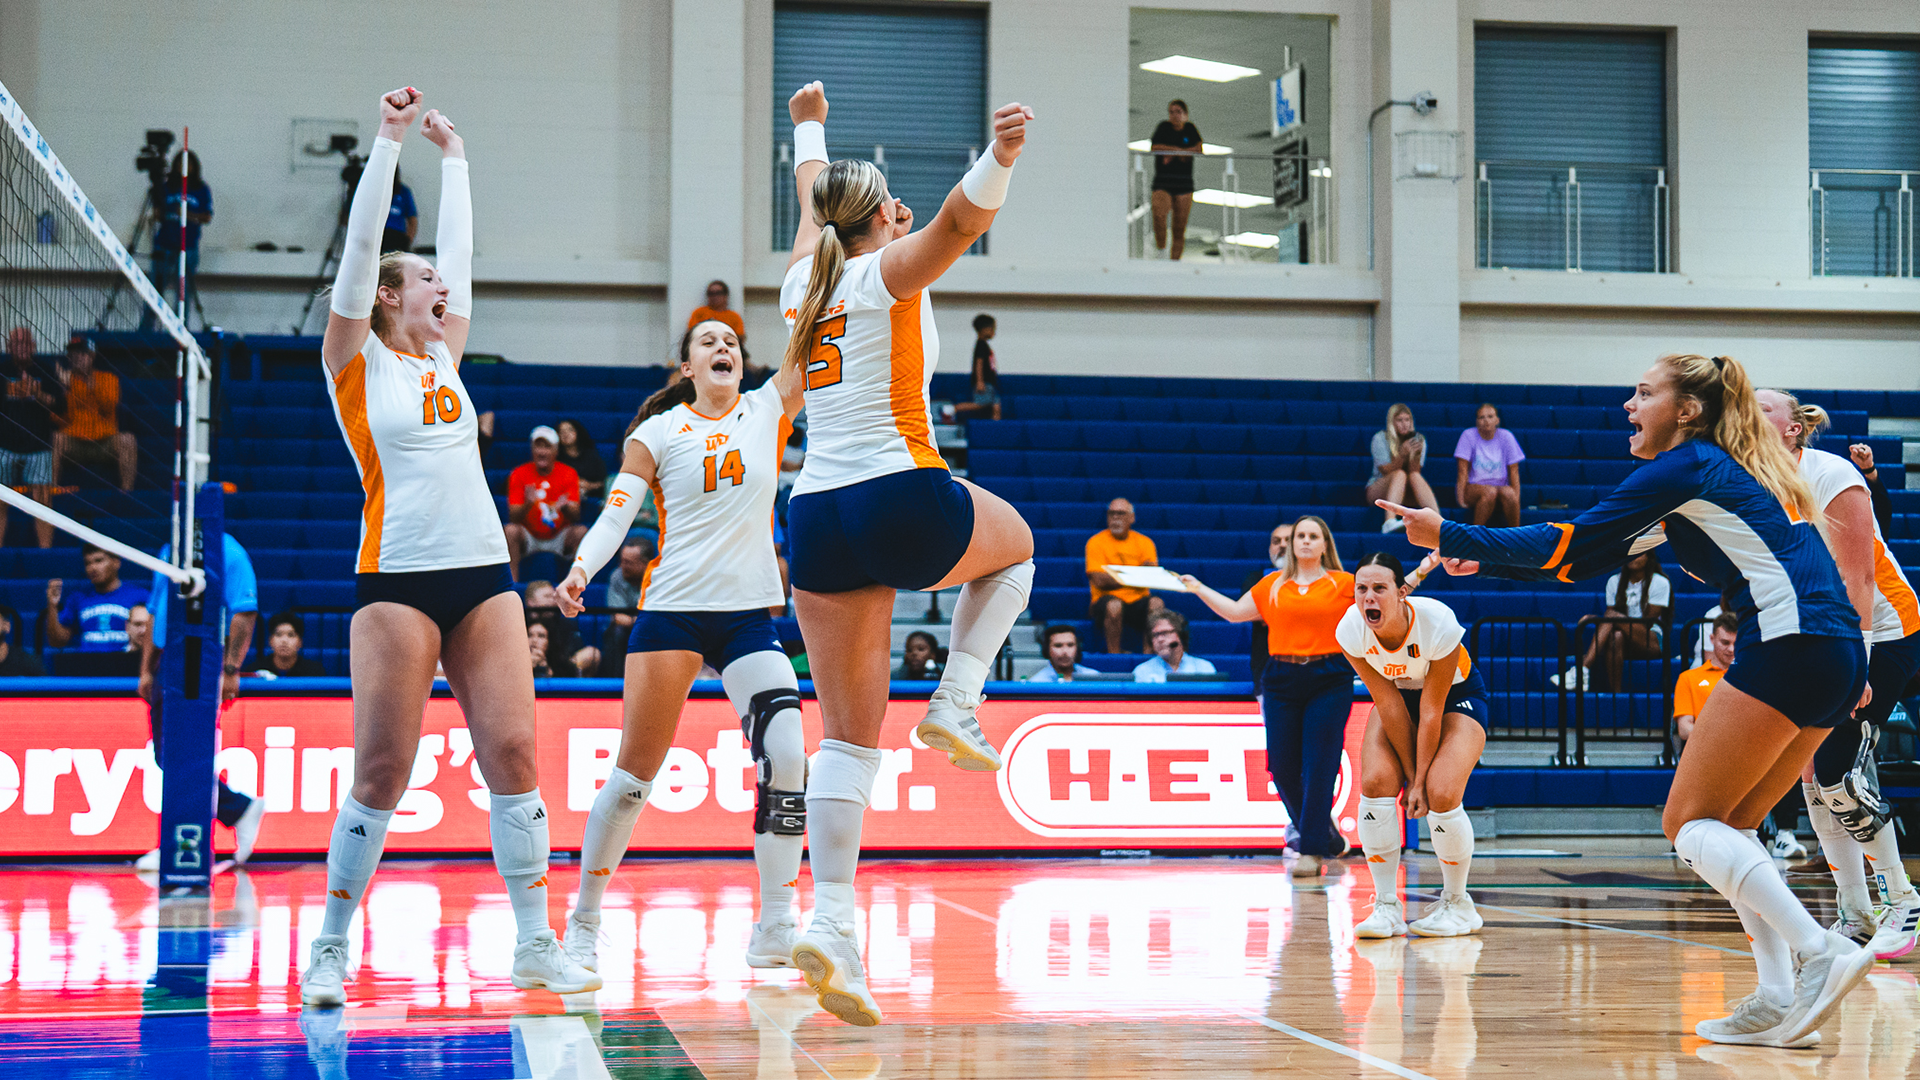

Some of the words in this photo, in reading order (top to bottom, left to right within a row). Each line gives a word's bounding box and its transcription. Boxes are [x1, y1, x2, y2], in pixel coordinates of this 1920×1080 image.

[423, 385, 462, 425] 10
[703, 449, 746, 493] 14
[1383, 663, 1407, 677] UTEP
[568, 727, 936, 812] Betr.
